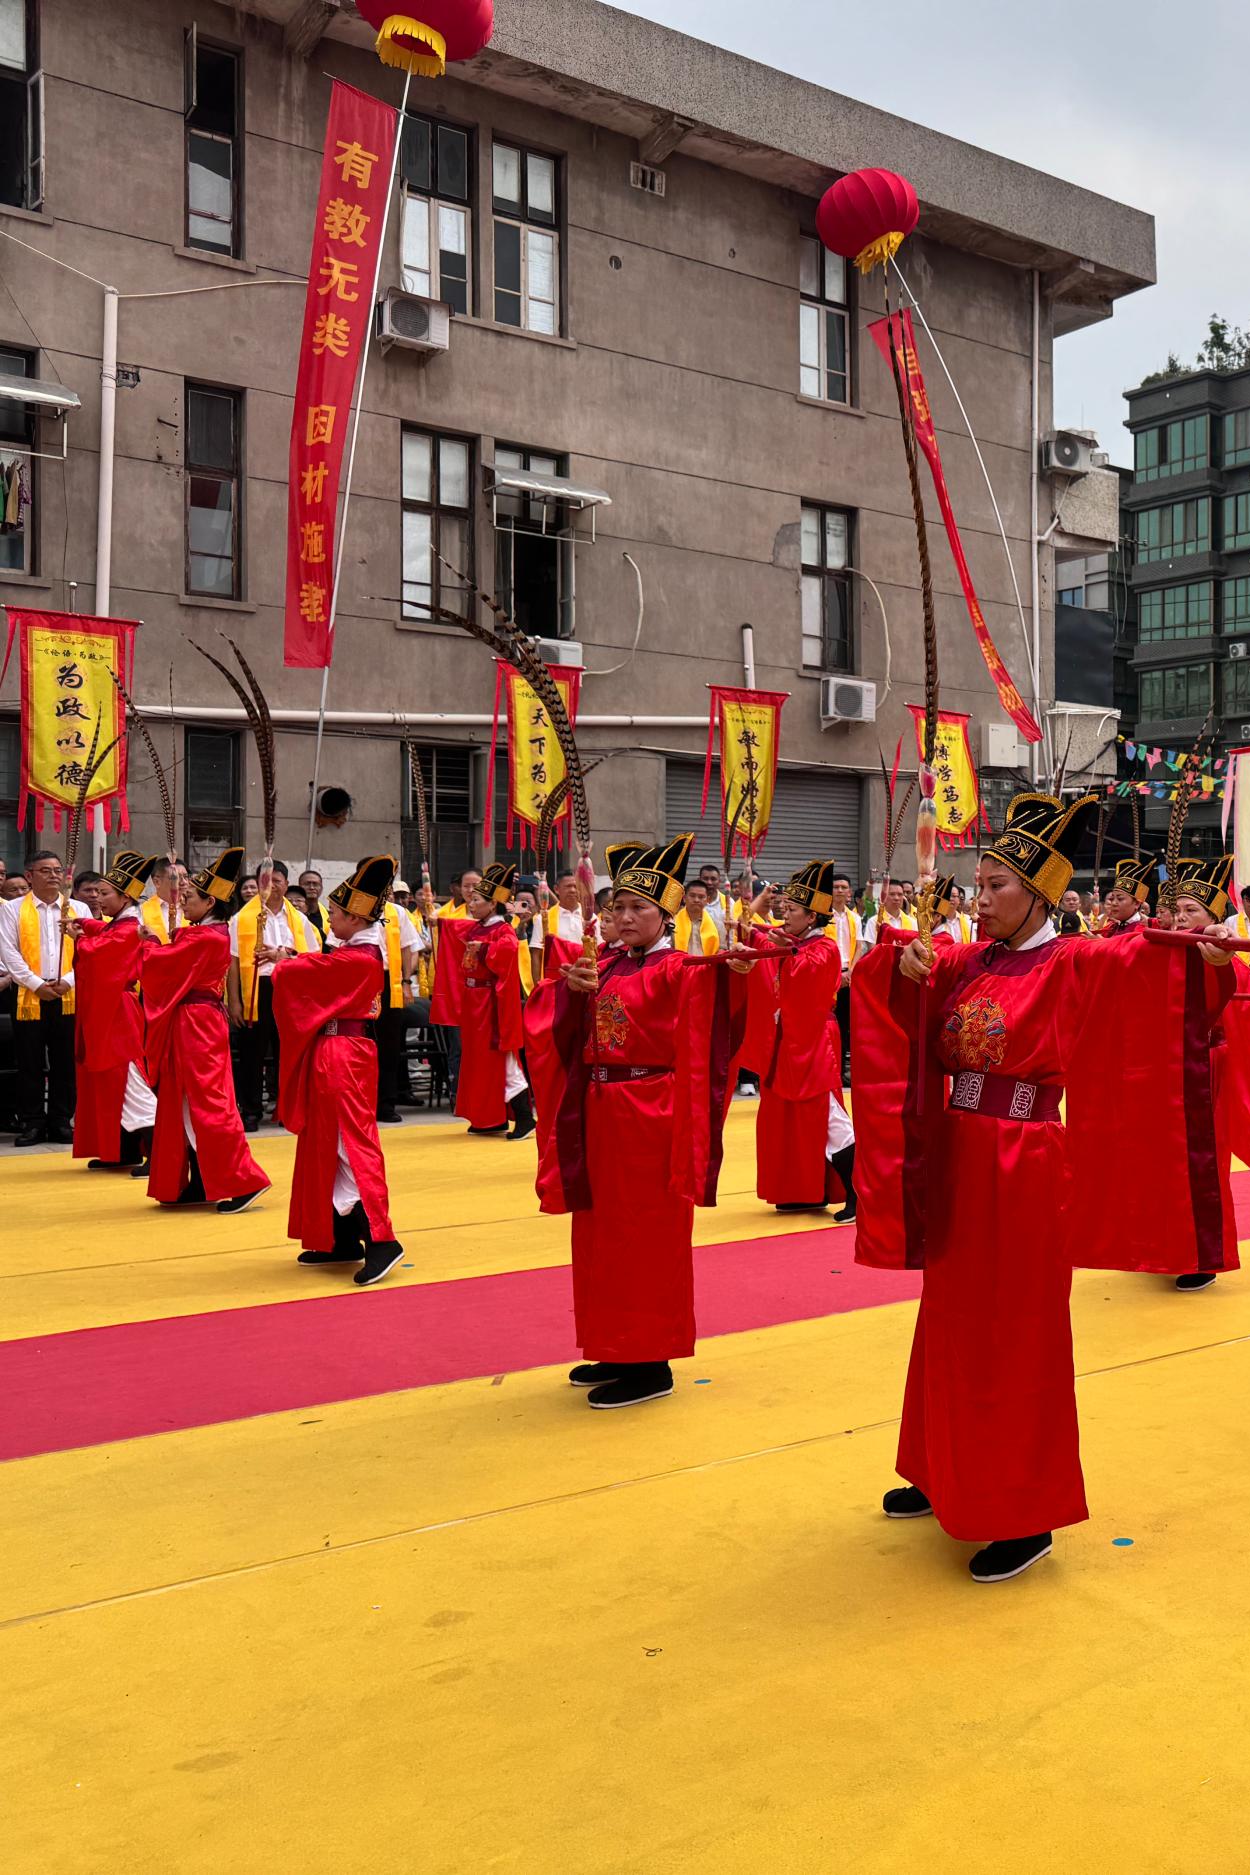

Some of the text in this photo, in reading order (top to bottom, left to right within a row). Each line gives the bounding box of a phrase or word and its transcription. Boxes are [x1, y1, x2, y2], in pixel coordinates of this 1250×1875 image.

[313, 139, 379, 358] 有教无类
[54, 663, 91, 787] 为政以德
[529, 707, 549, 810] 天下为公
[934, 743, 963, 825] 博学笃志
